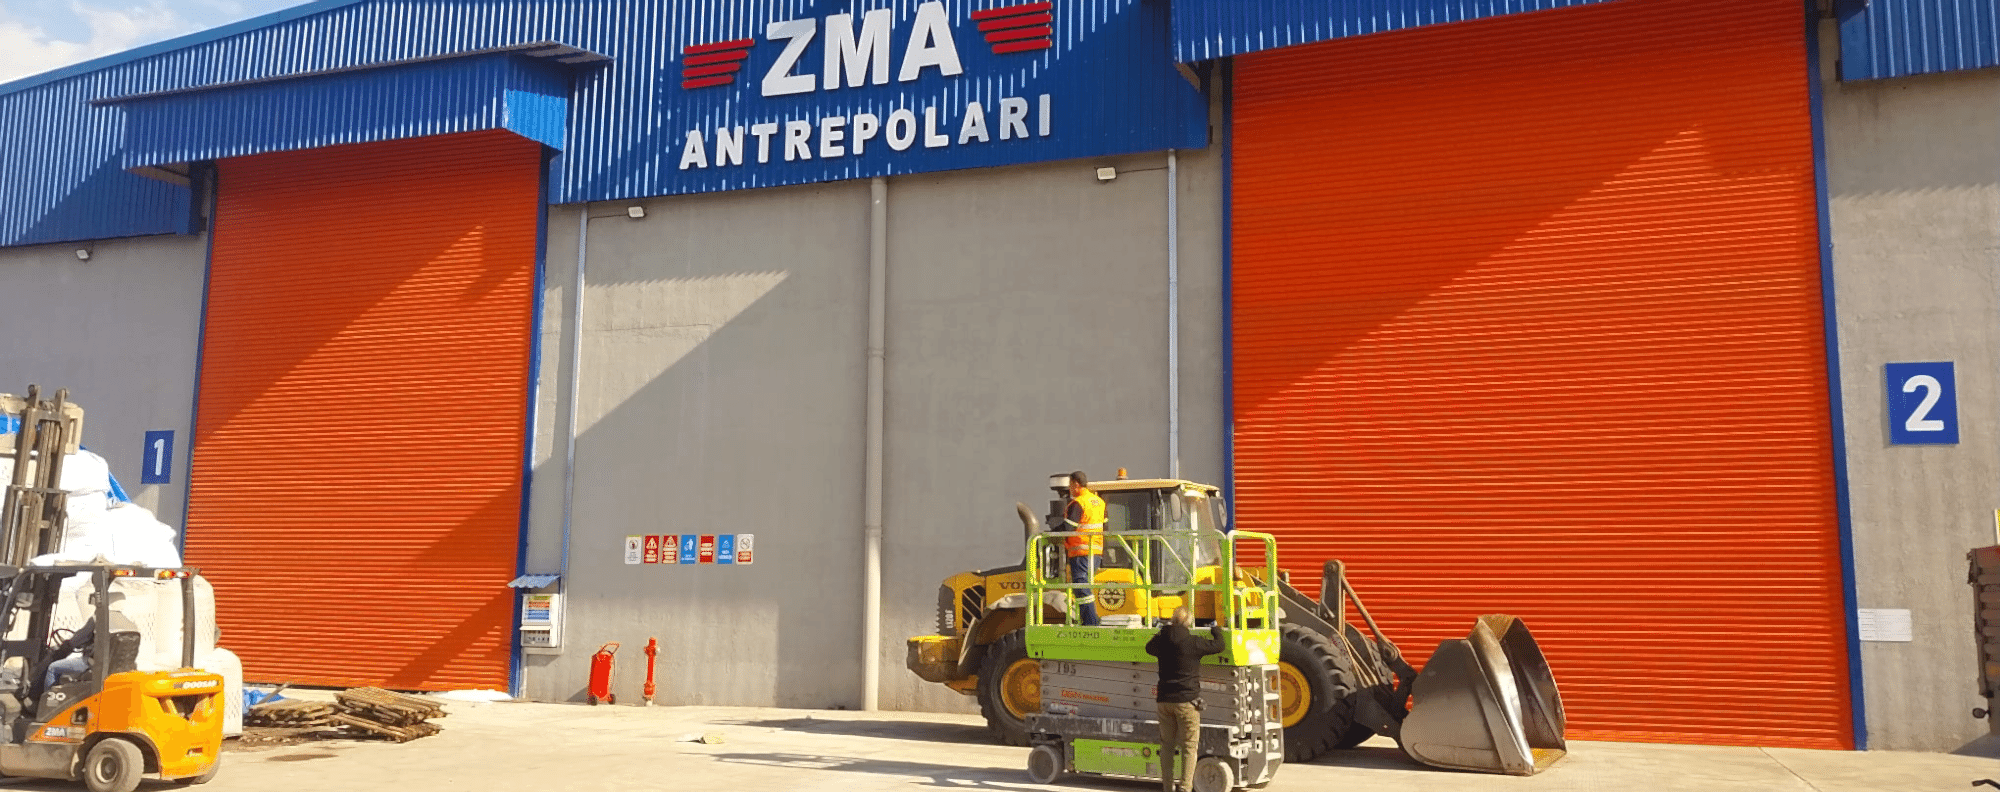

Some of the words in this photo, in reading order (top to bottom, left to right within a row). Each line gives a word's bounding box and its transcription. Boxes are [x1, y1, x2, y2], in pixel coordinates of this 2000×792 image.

[761, 0, 963, 97] ZMA
[679, 94, 1051, 169] ANTREPOLARI
[1903, 375, 1945, 431] 2
[154, 438, 165, 475] 1
